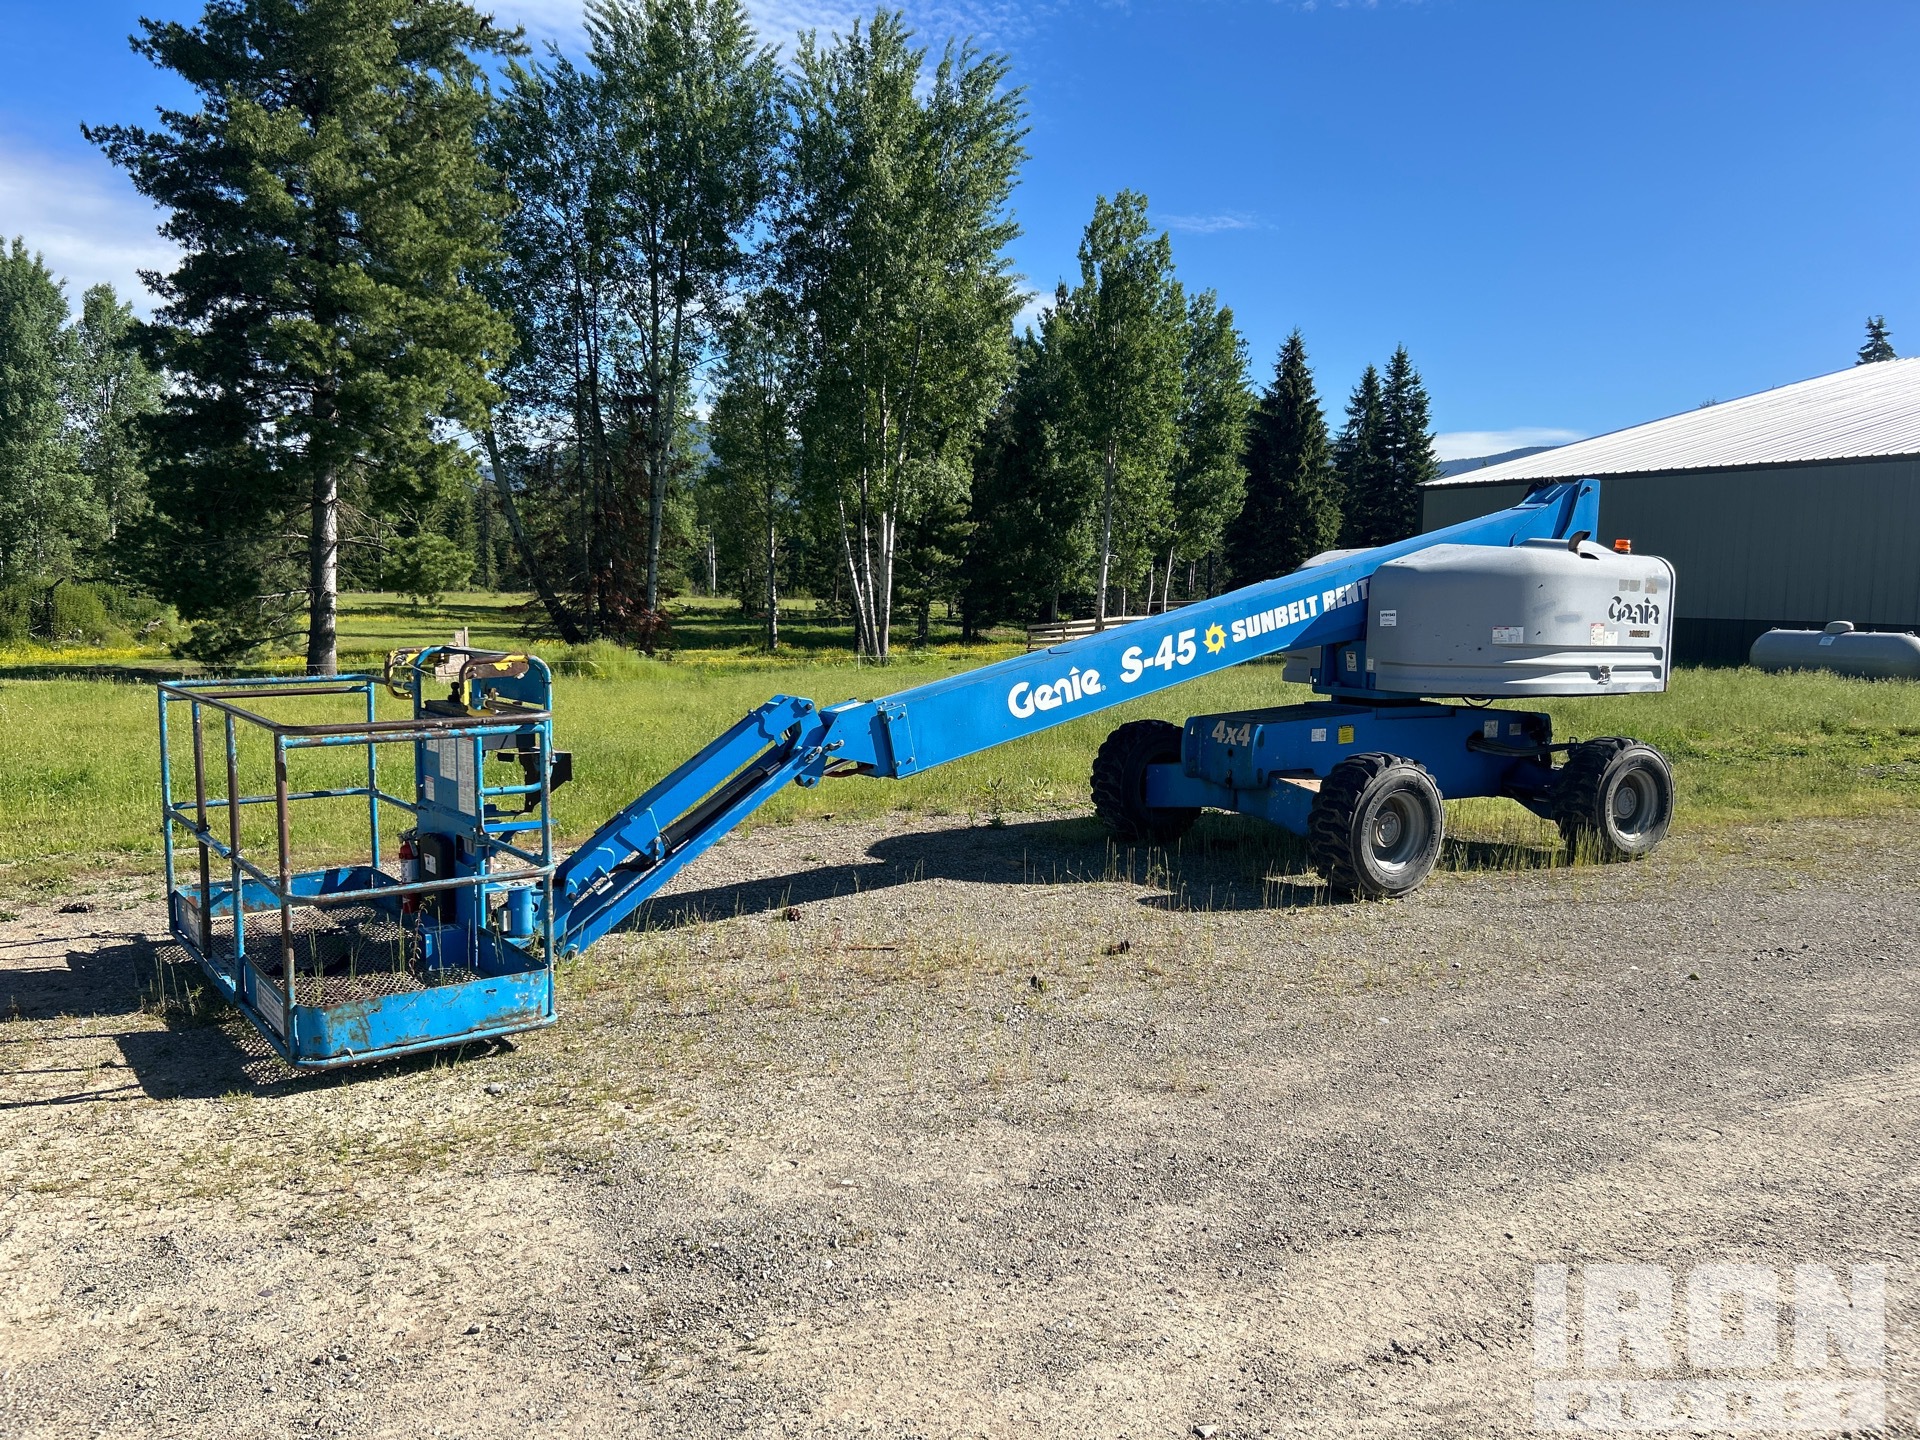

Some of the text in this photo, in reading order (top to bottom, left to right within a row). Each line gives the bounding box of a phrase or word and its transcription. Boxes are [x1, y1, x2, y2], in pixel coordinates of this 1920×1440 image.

[1230, 578, 1370, 643] SUNBELT RENT
[1119, 628, 1197, 684] S-45
[1211, 719, 1251, 747] 4x4
